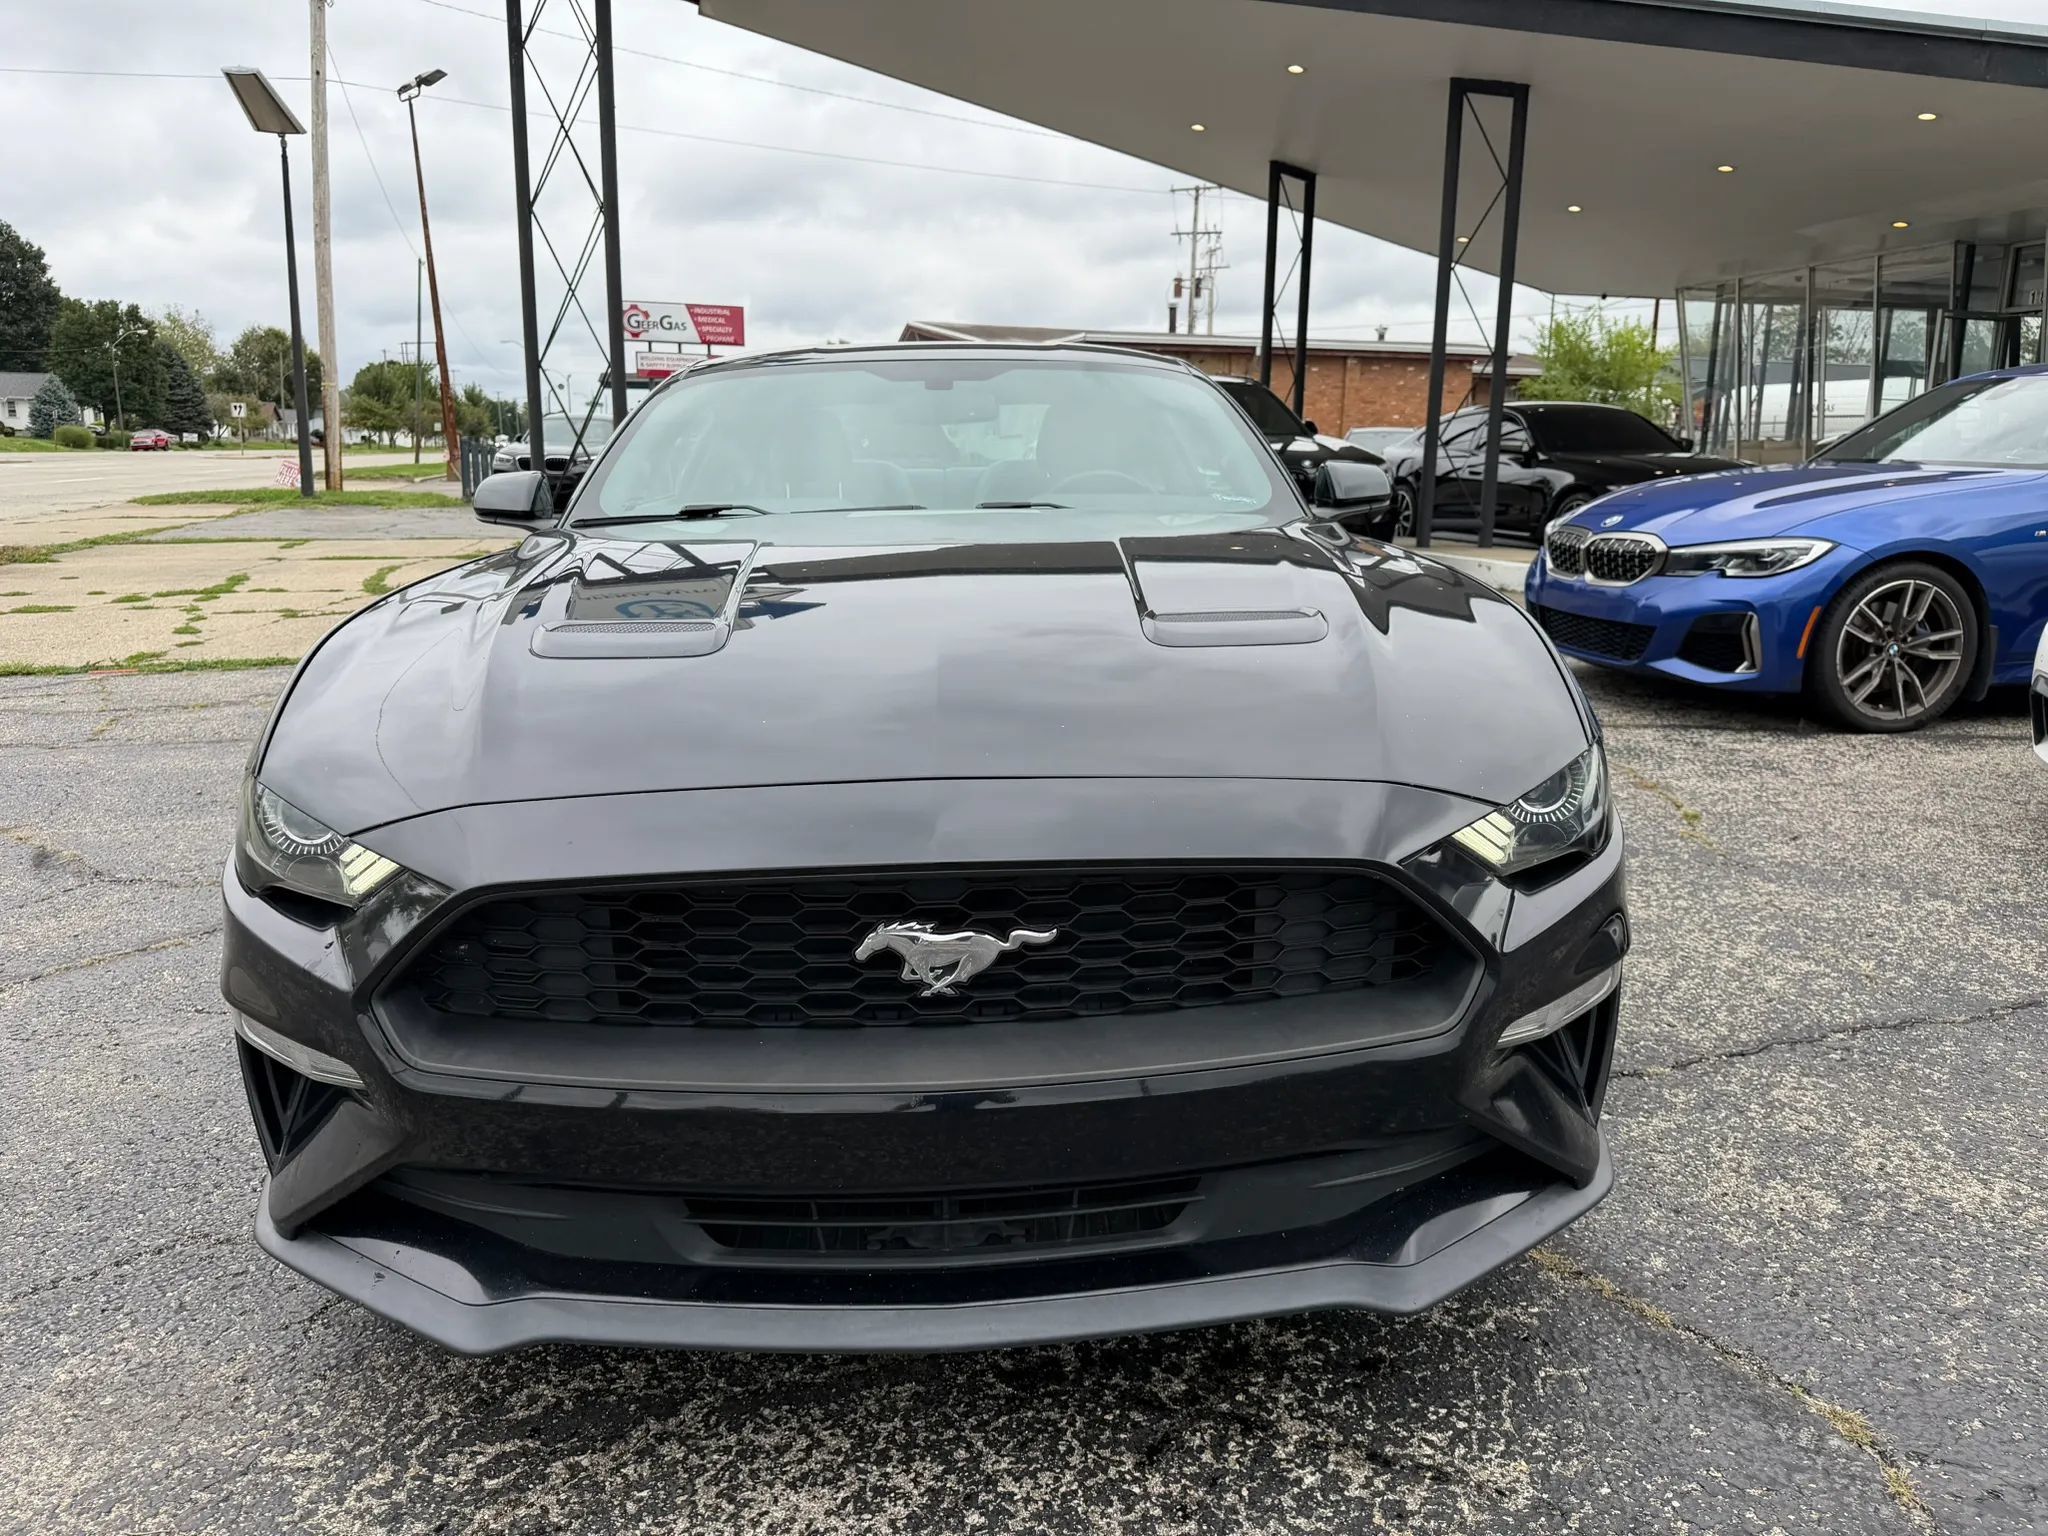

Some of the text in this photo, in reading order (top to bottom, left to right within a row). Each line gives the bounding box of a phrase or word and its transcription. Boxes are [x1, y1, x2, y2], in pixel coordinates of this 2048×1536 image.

[693, 307, 731, 316] INDUSTRIAL
[697, 316, 726, 324] MEDICAL
[705, 335, 735, 343] PROPANE
